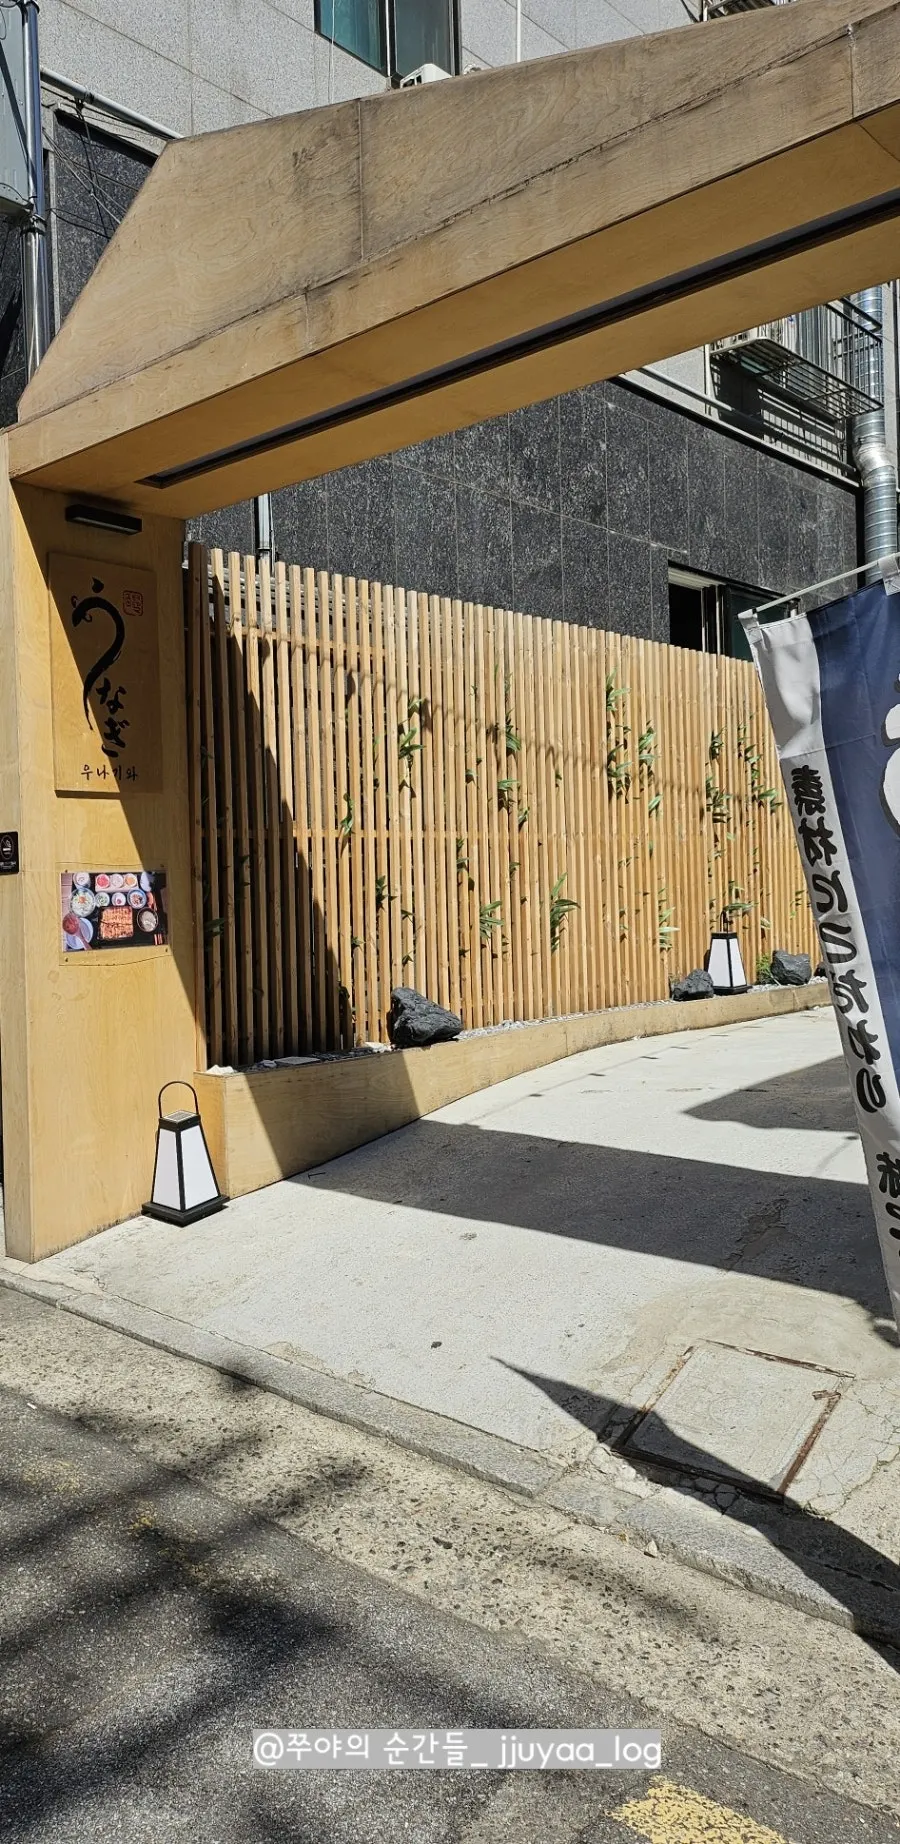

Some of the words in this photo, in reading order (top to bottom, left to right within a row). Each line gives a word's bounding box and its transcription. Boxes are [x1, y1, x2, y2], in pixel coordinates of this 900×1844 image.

[71, 576, 130, 758] うなぎ
[80, 764, 139, 782] 우나기와
